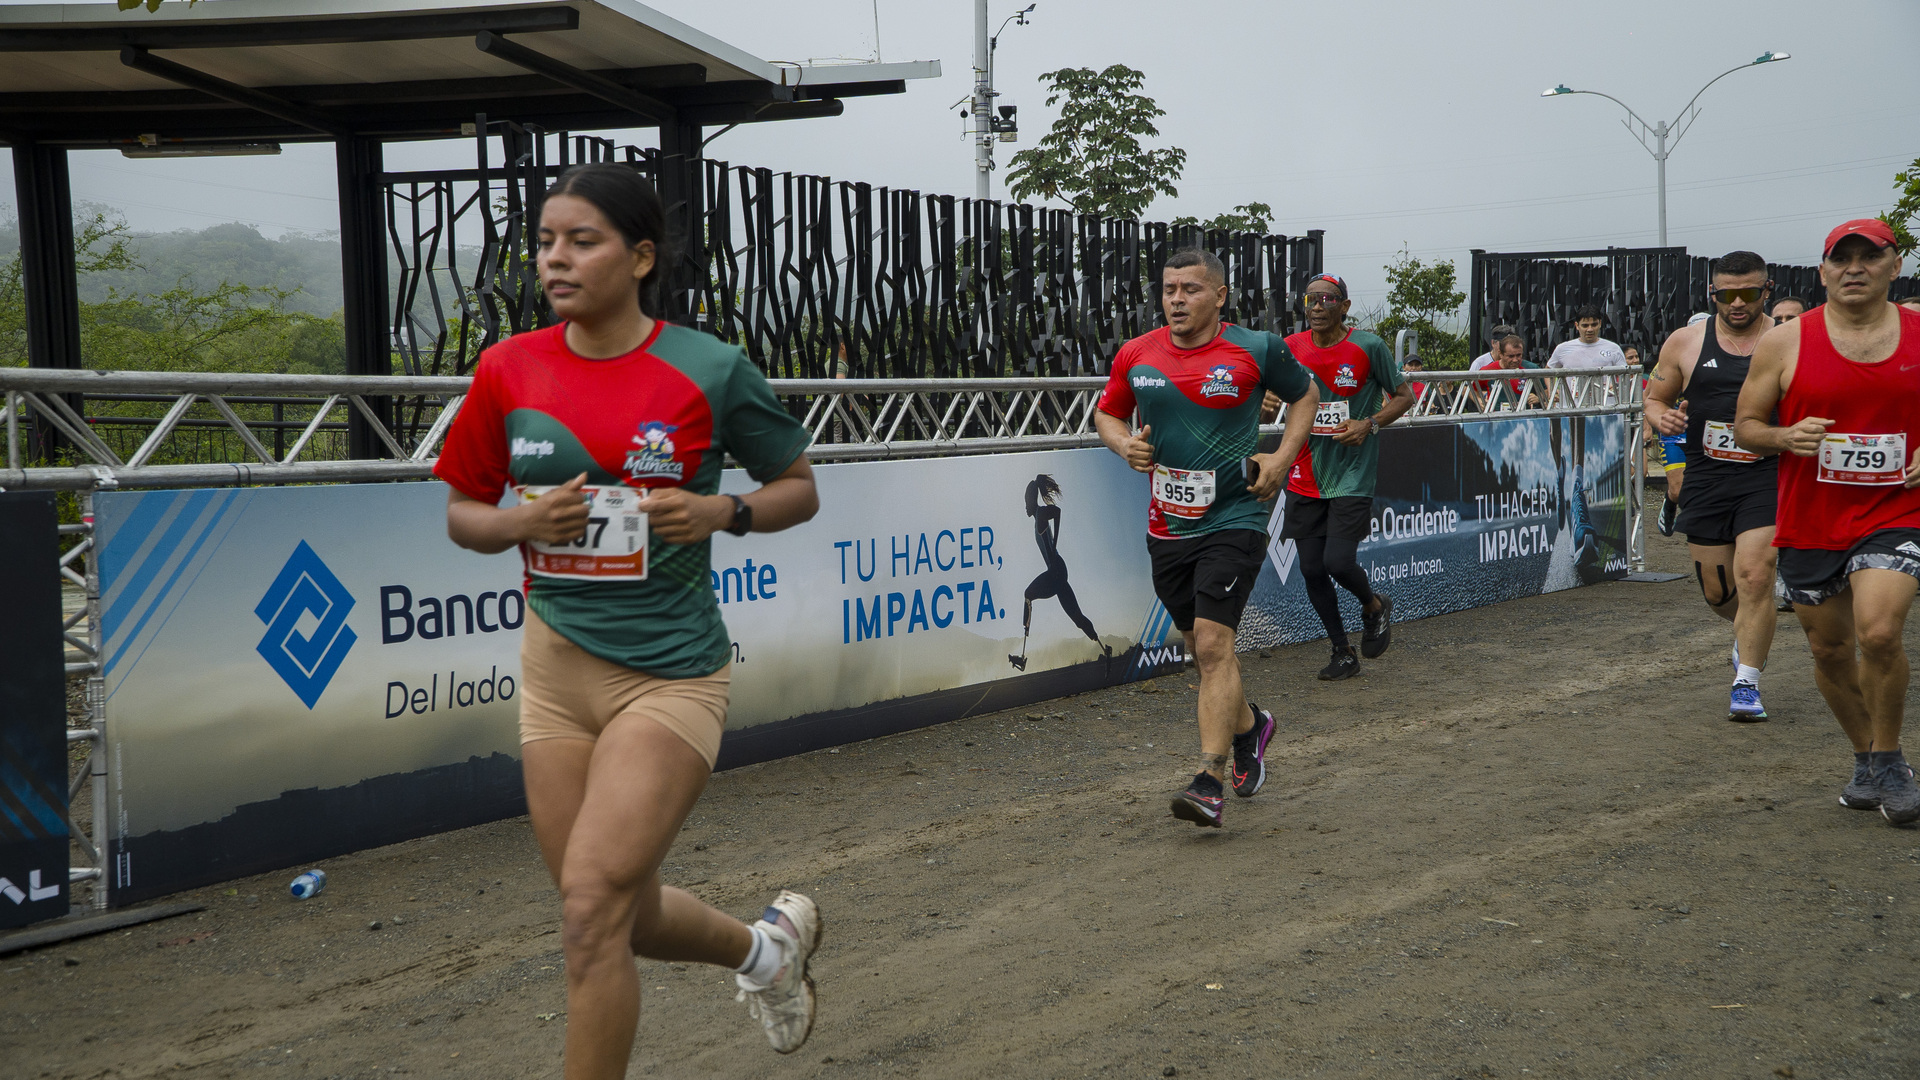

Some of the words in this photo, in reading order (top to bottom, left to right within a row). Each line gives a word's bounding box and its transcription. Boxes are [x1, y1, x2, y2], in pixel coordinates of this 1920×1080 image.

[623, 455, 684, 476] Muñeca
[641, 451, 655, 461] La
[1841, 450, 1886, 468] 759
[1165, 483, 1195, 503] 955
[1475, 494, 1495, 523] TU
[1500, 488, 1552, 519] HACER,
[1361, 517, 1379, 543] e
[1382, 504, 1457, 540] Occidente
[834, 540, 876, 584] TU
[891, 526, 1003, 577] HACER,
[1479, 524, 1553, 563] IMPACTA.
[1372, 561, 1386, 582] los
[1389, 562, 1408, 584] que
[1410, 555, 1444, 576] hacen.
[1604, 557, 1627, 573] AVAL
[380, 584, 526, 645] Banco
[843, 579, 1006, 644] IMPACTA.
[1137, 645, 1182, 669] AVAL
[385, 673, 437, 719] Del
[448, 665, 515, 709] lado
